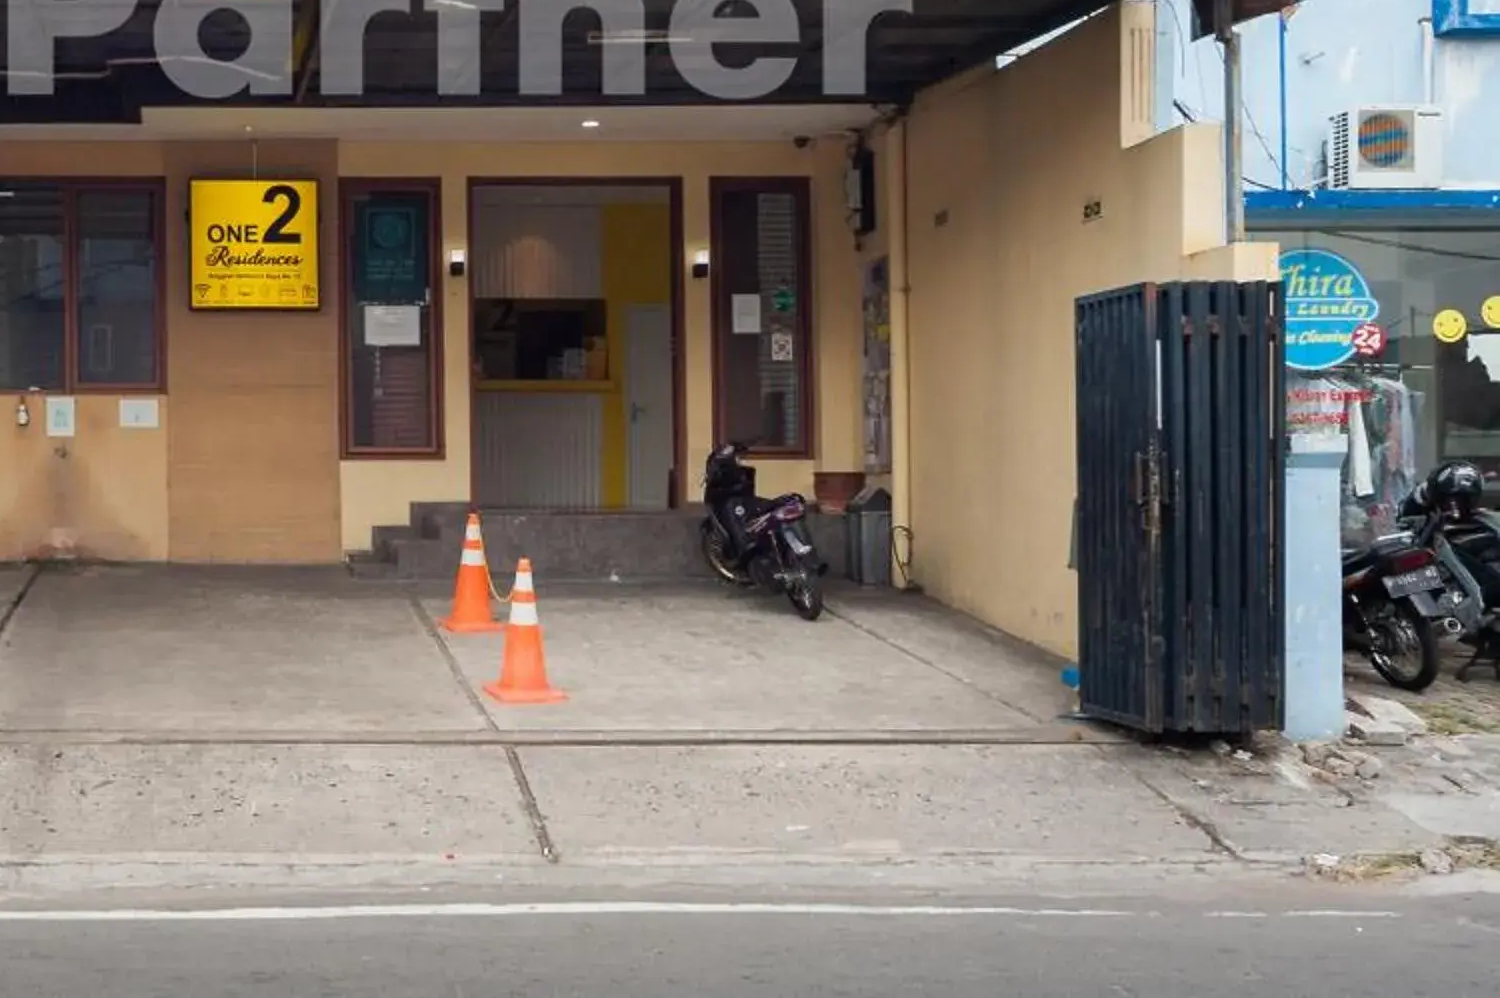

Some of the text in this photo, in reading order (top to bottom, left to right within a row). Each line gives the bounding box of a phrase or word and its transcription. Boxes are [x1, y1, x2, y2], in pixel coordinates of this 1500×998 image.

[262, 185, 302, 243] 2
[207, 224, 258, 243] ONE
[206, 246, 304, 267] Residences
[1354, 329, 1381, 350] 24
